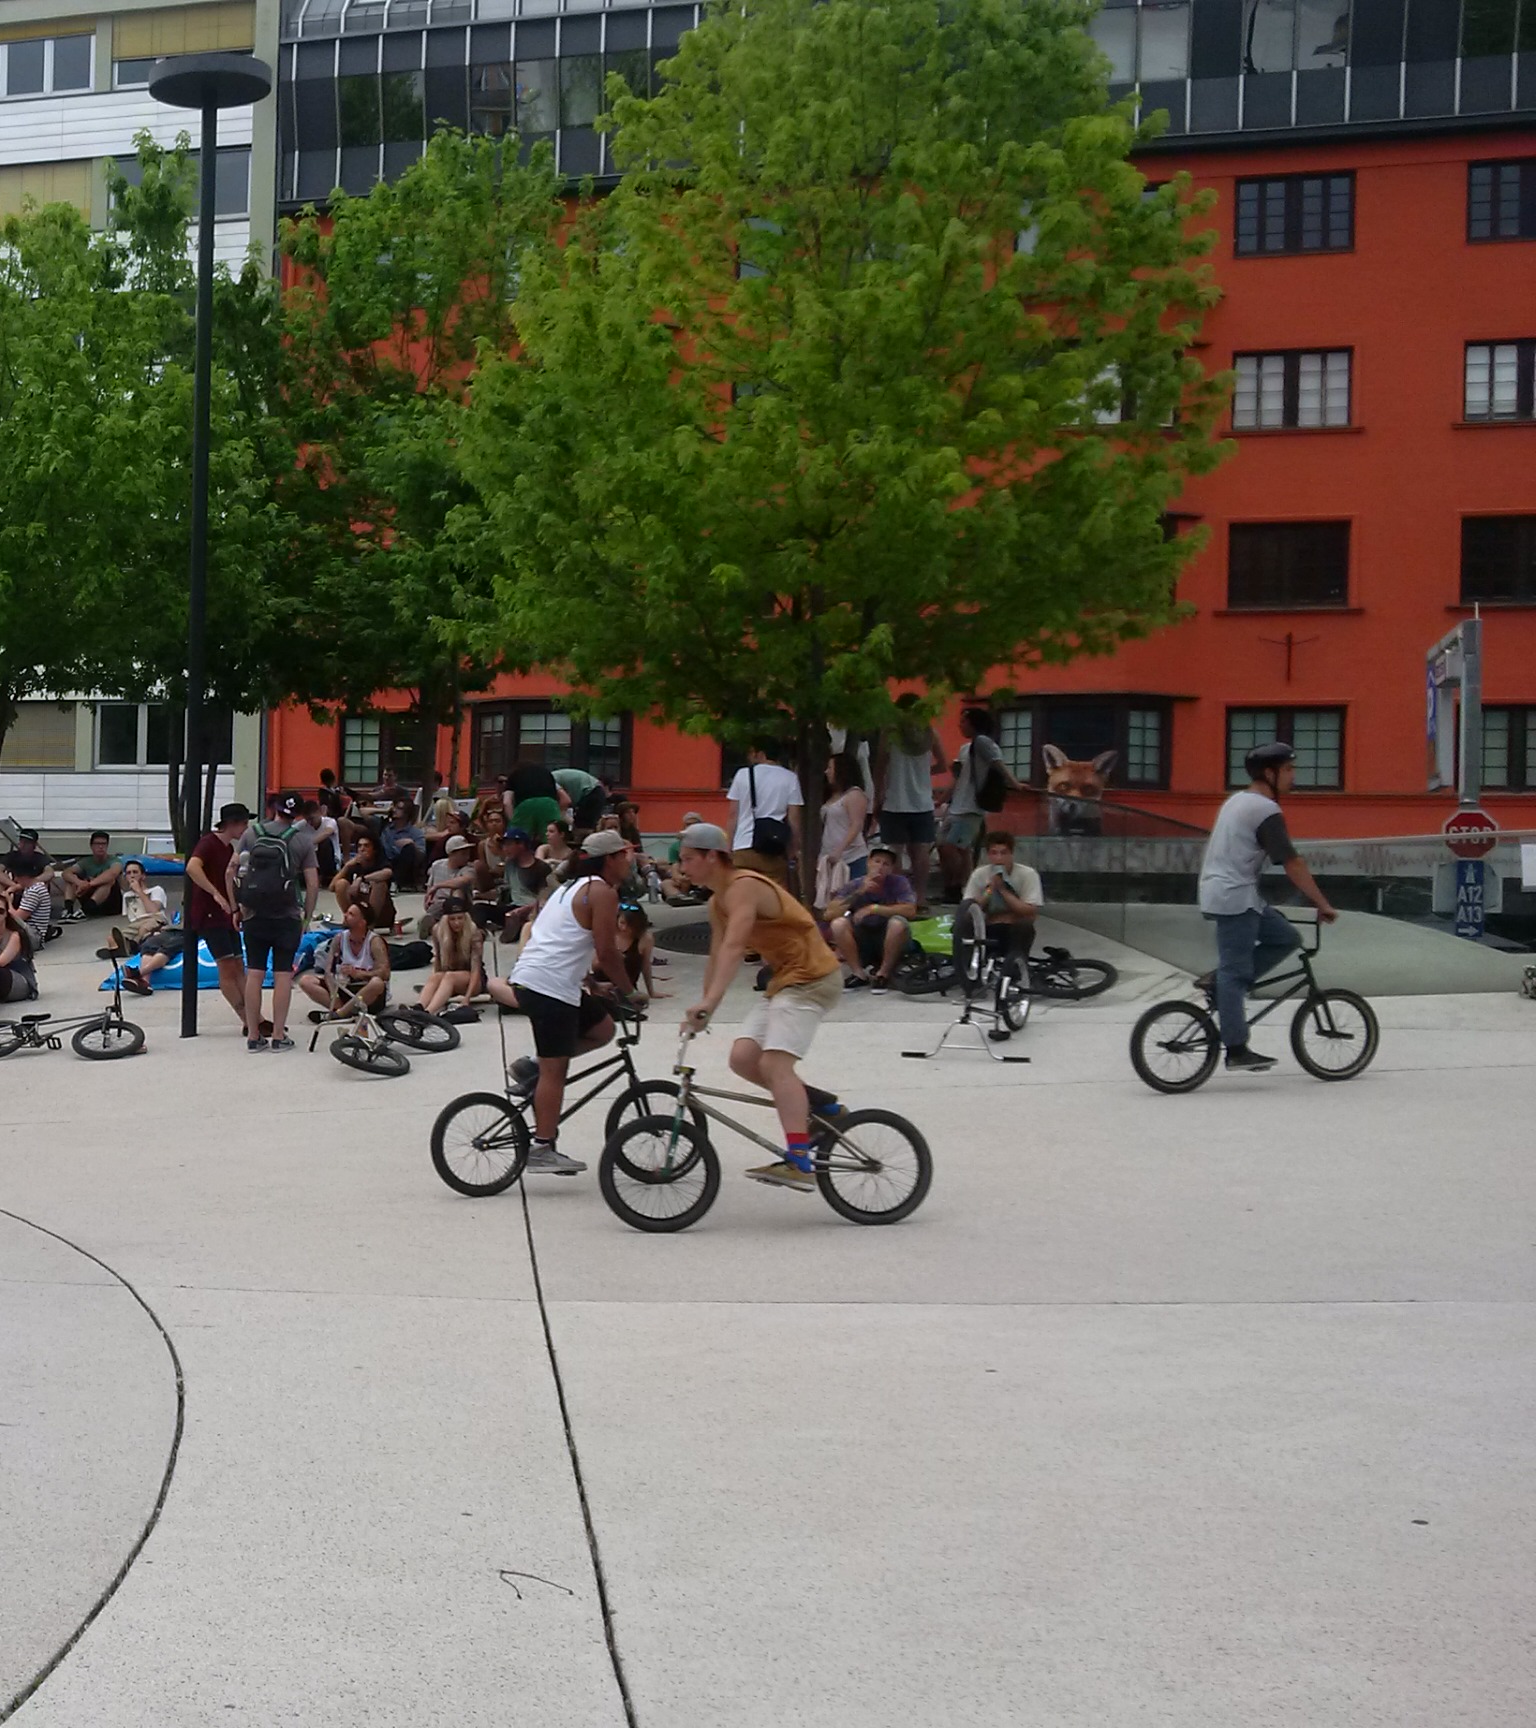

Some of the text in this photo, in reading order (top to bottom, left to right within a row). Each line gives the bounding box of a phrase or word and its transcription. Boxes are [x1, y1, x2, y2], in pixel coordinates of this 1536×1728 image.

[1449, 826, 1492, 844] STOP
[1457, 885, 1483, 903] A12
[1456, 905, 1482, 923] A13
